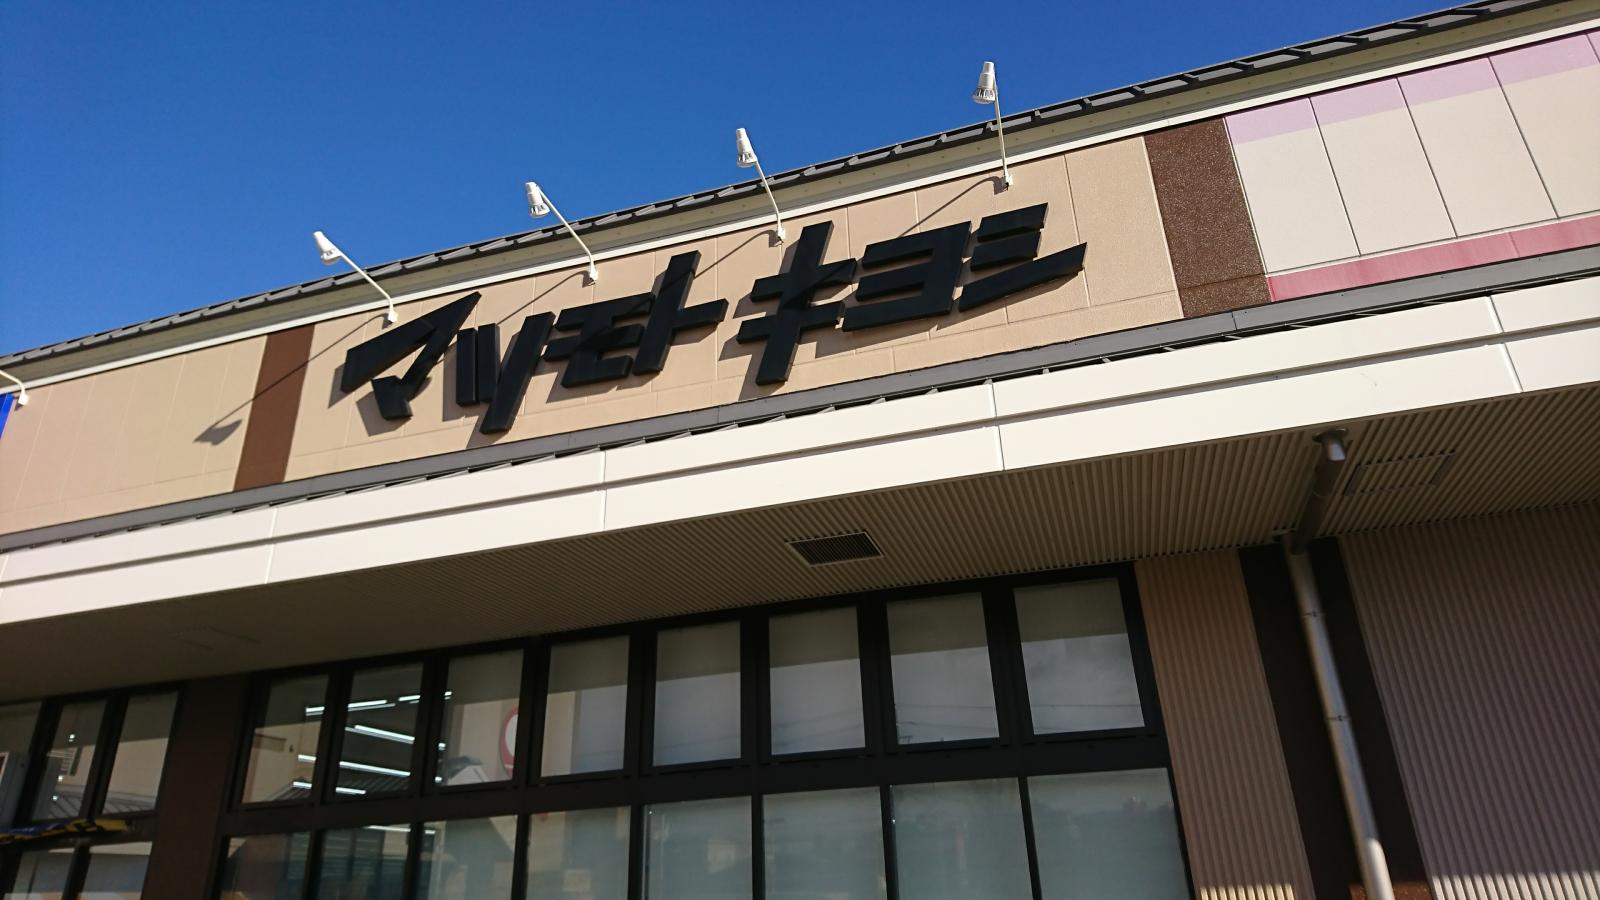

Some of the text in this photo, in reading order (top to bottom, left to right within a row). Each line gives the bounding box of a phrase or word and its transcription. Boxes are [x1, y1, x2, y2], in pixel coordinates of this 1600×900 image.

[341, 203, 1087, 433] マツモトキヨシ
